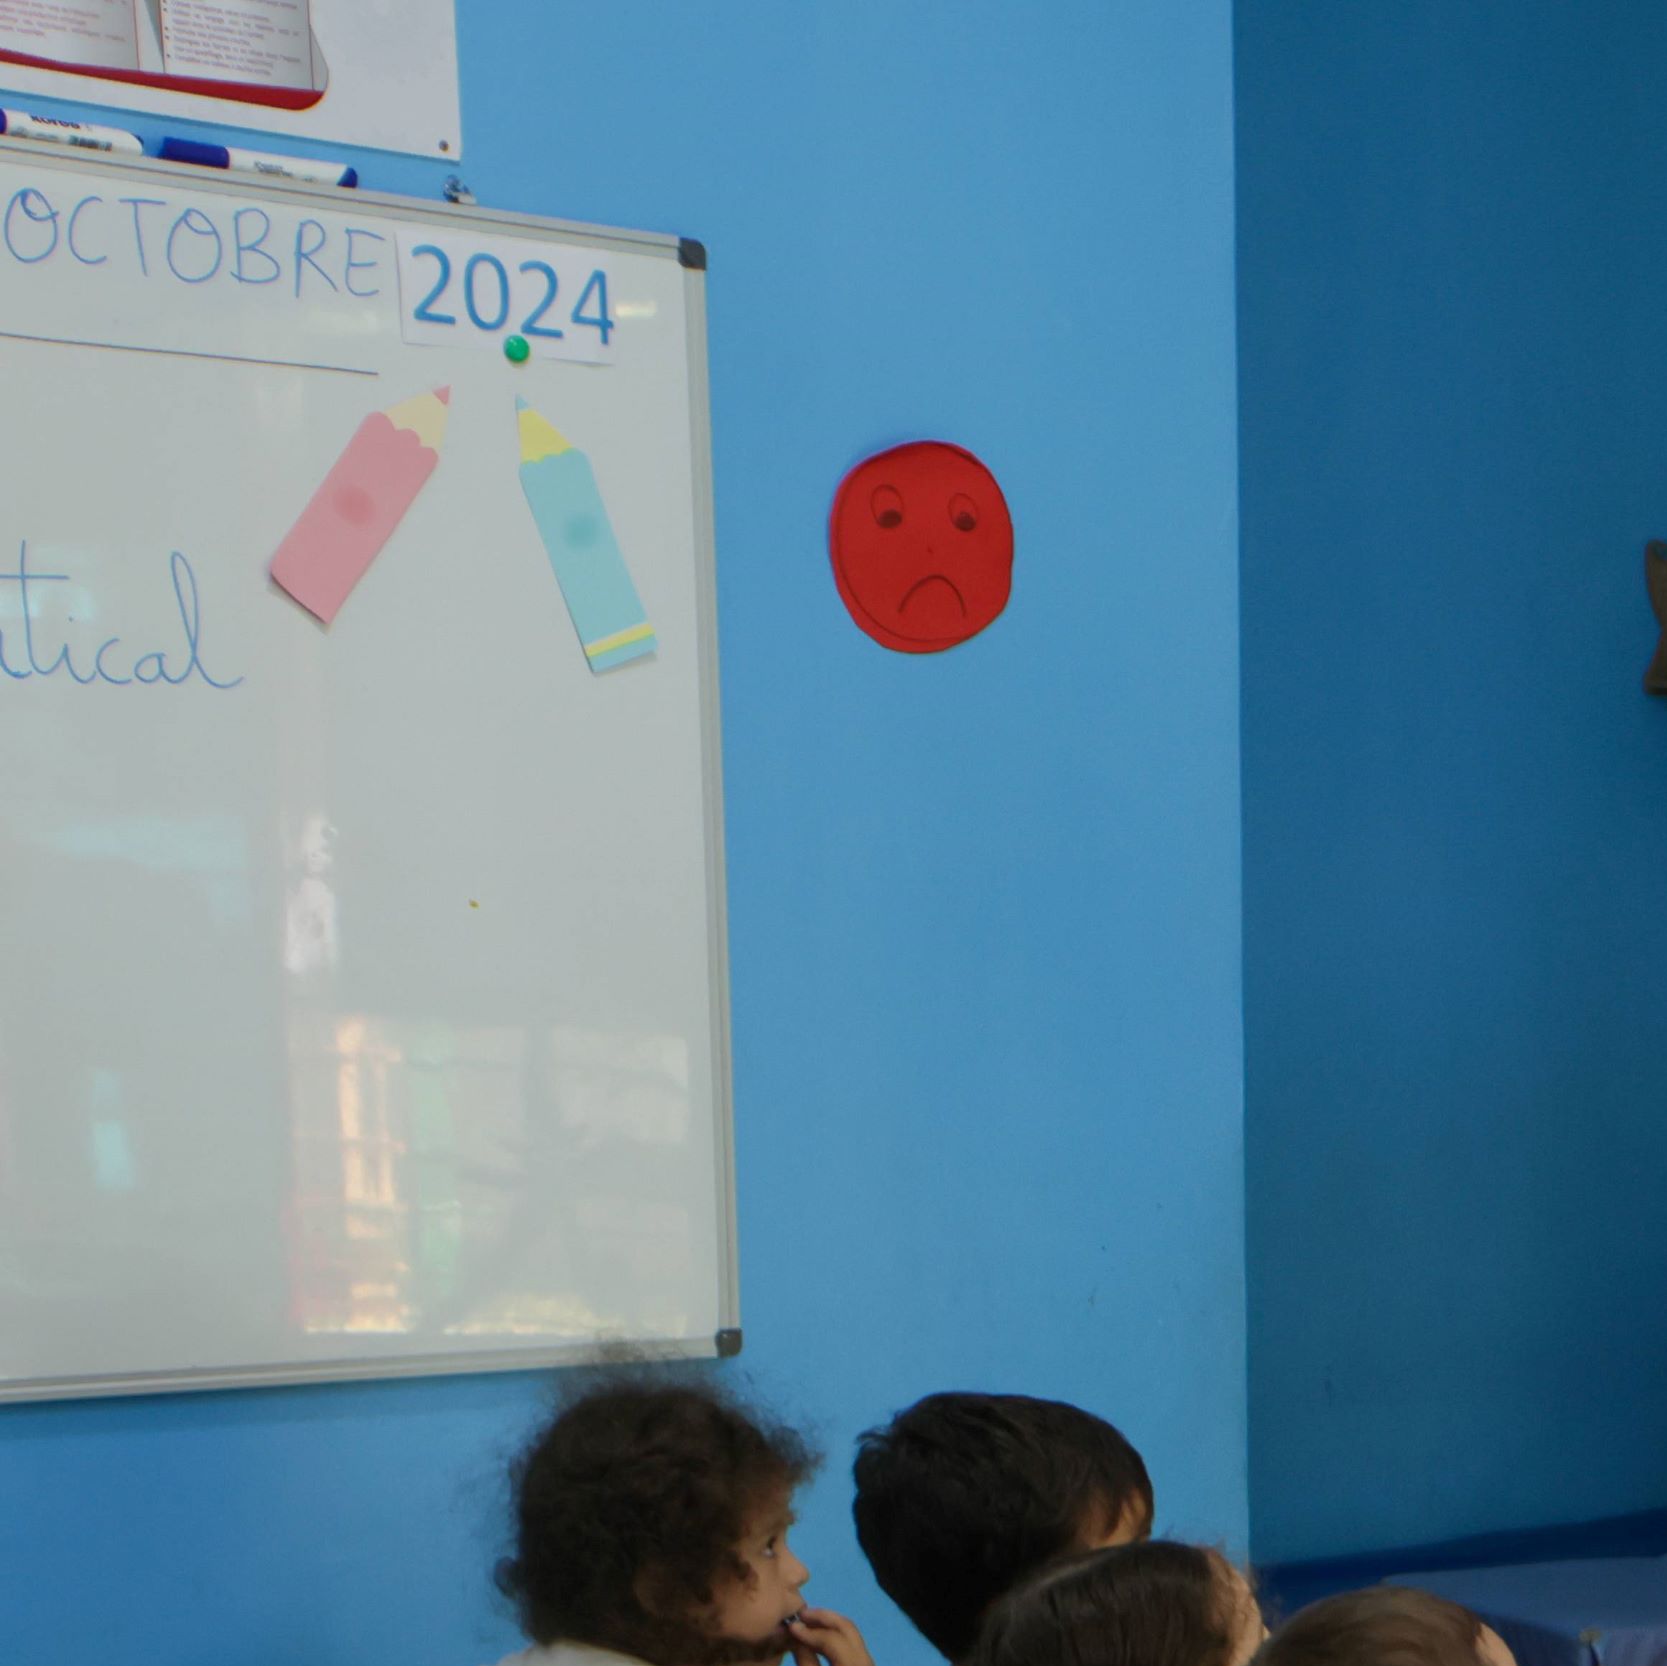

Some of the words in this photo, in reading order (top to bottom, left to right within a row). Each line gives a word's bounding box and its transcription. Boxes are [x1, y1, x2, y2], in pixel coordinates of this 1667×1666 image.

[4, 187, 385, 298] OCTOBRE
[410, 243, 615, 345] 2024
[0, 540, 245, 689] tical
